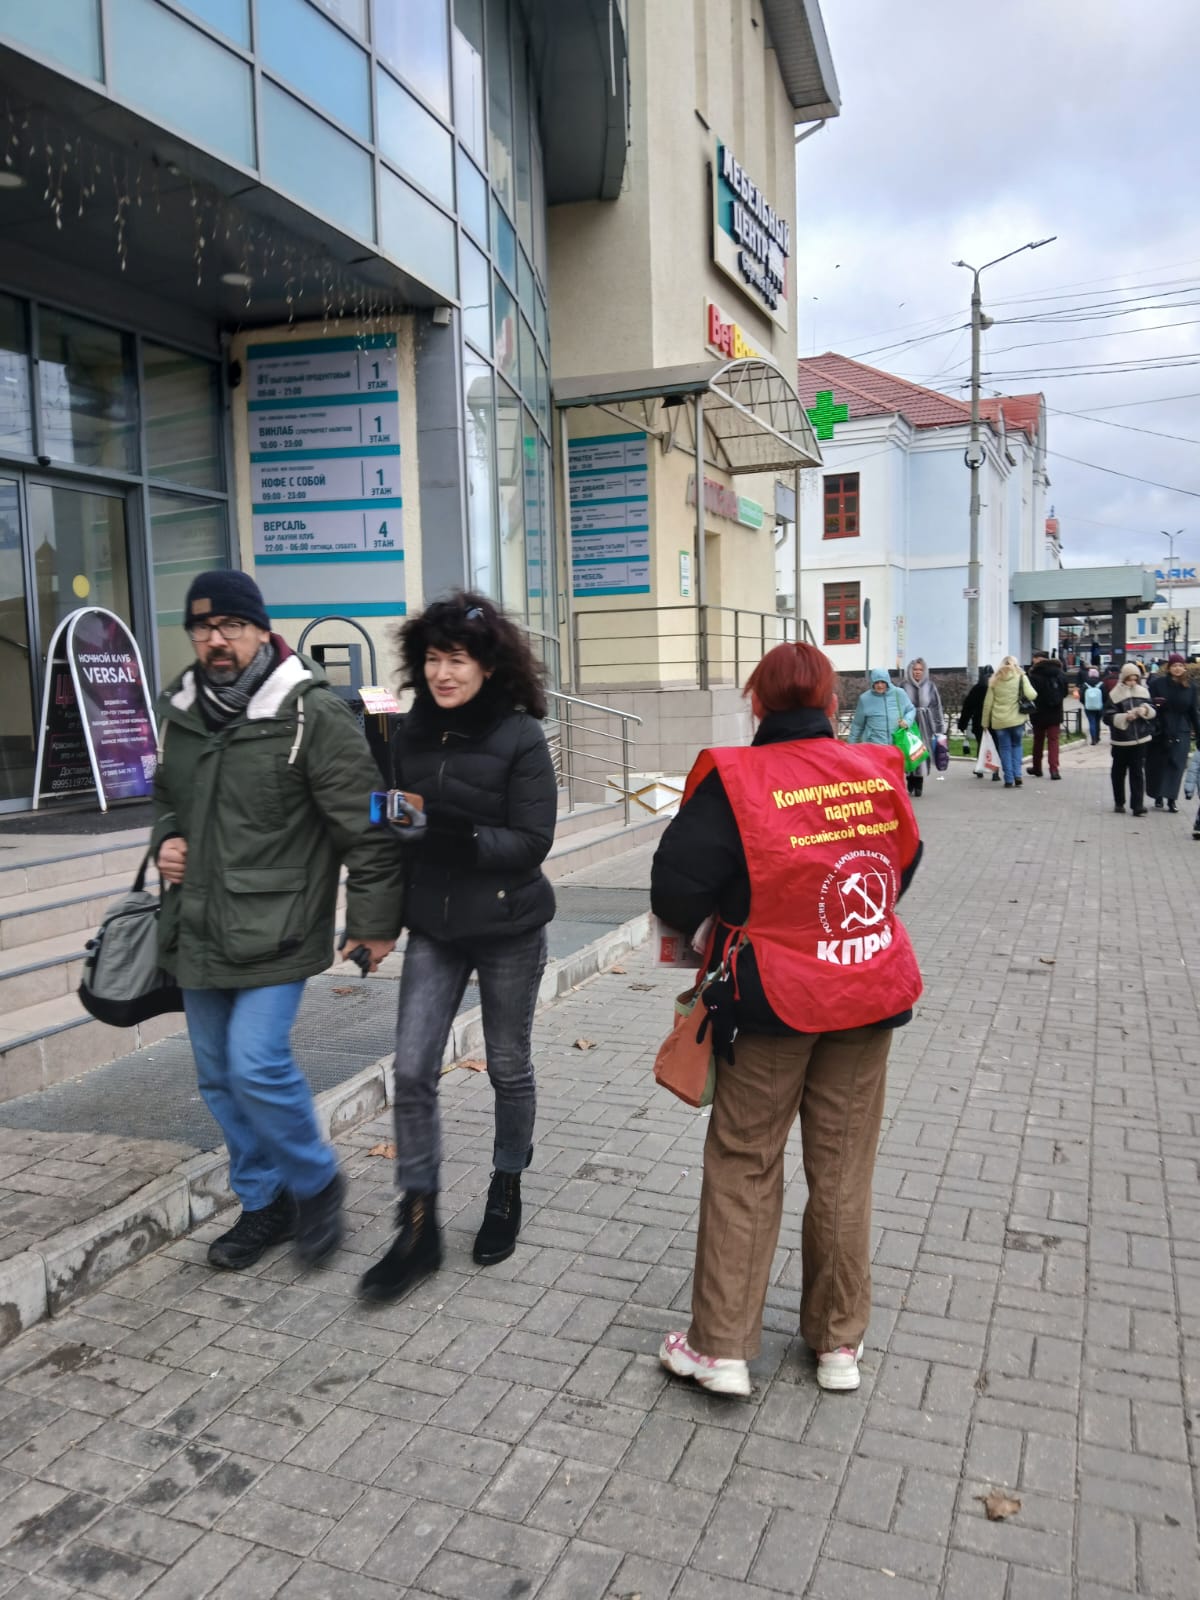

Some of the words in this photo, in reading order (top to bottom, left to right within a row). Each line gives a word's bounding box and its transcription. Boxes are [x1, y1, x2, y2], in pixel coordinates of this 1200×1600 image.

[721, 145, 790, 257] МЕБЕЛЬНЫЙ
[730, 201, 769, 264] ЦЕНТР
[372, 361, 380, 379] 1
[367, 380, 388, 390] ЭТАЖ
[258, 426, 294, 437] ВИНЛАБ
[374, 416, 382, 433] 1
[368, 434, 390, 444] ЭТАЖ
[262, 477, 286, 488] КОФЕ
[289, 476, 294, 487] С
[296, 474, 326, 486] СОБОЙ
[376, 468, 384, 486] 1
[370, 487, 392, 496] ЭТАЖ
[264, 520, 306, 532] ВЕРСАЛЬ
[378, 520, 388, 538] 4
[374, 540, 394, 548] ЭТАЖ
[78, 652, 111, 664] НОЧНОЙ
[112, 654, 132, 663] КЛУБ
[83, 666, 136, 684] VERSAL
[824, 800, 874, 822] партия
[790, 826, 855, 848] Российской
